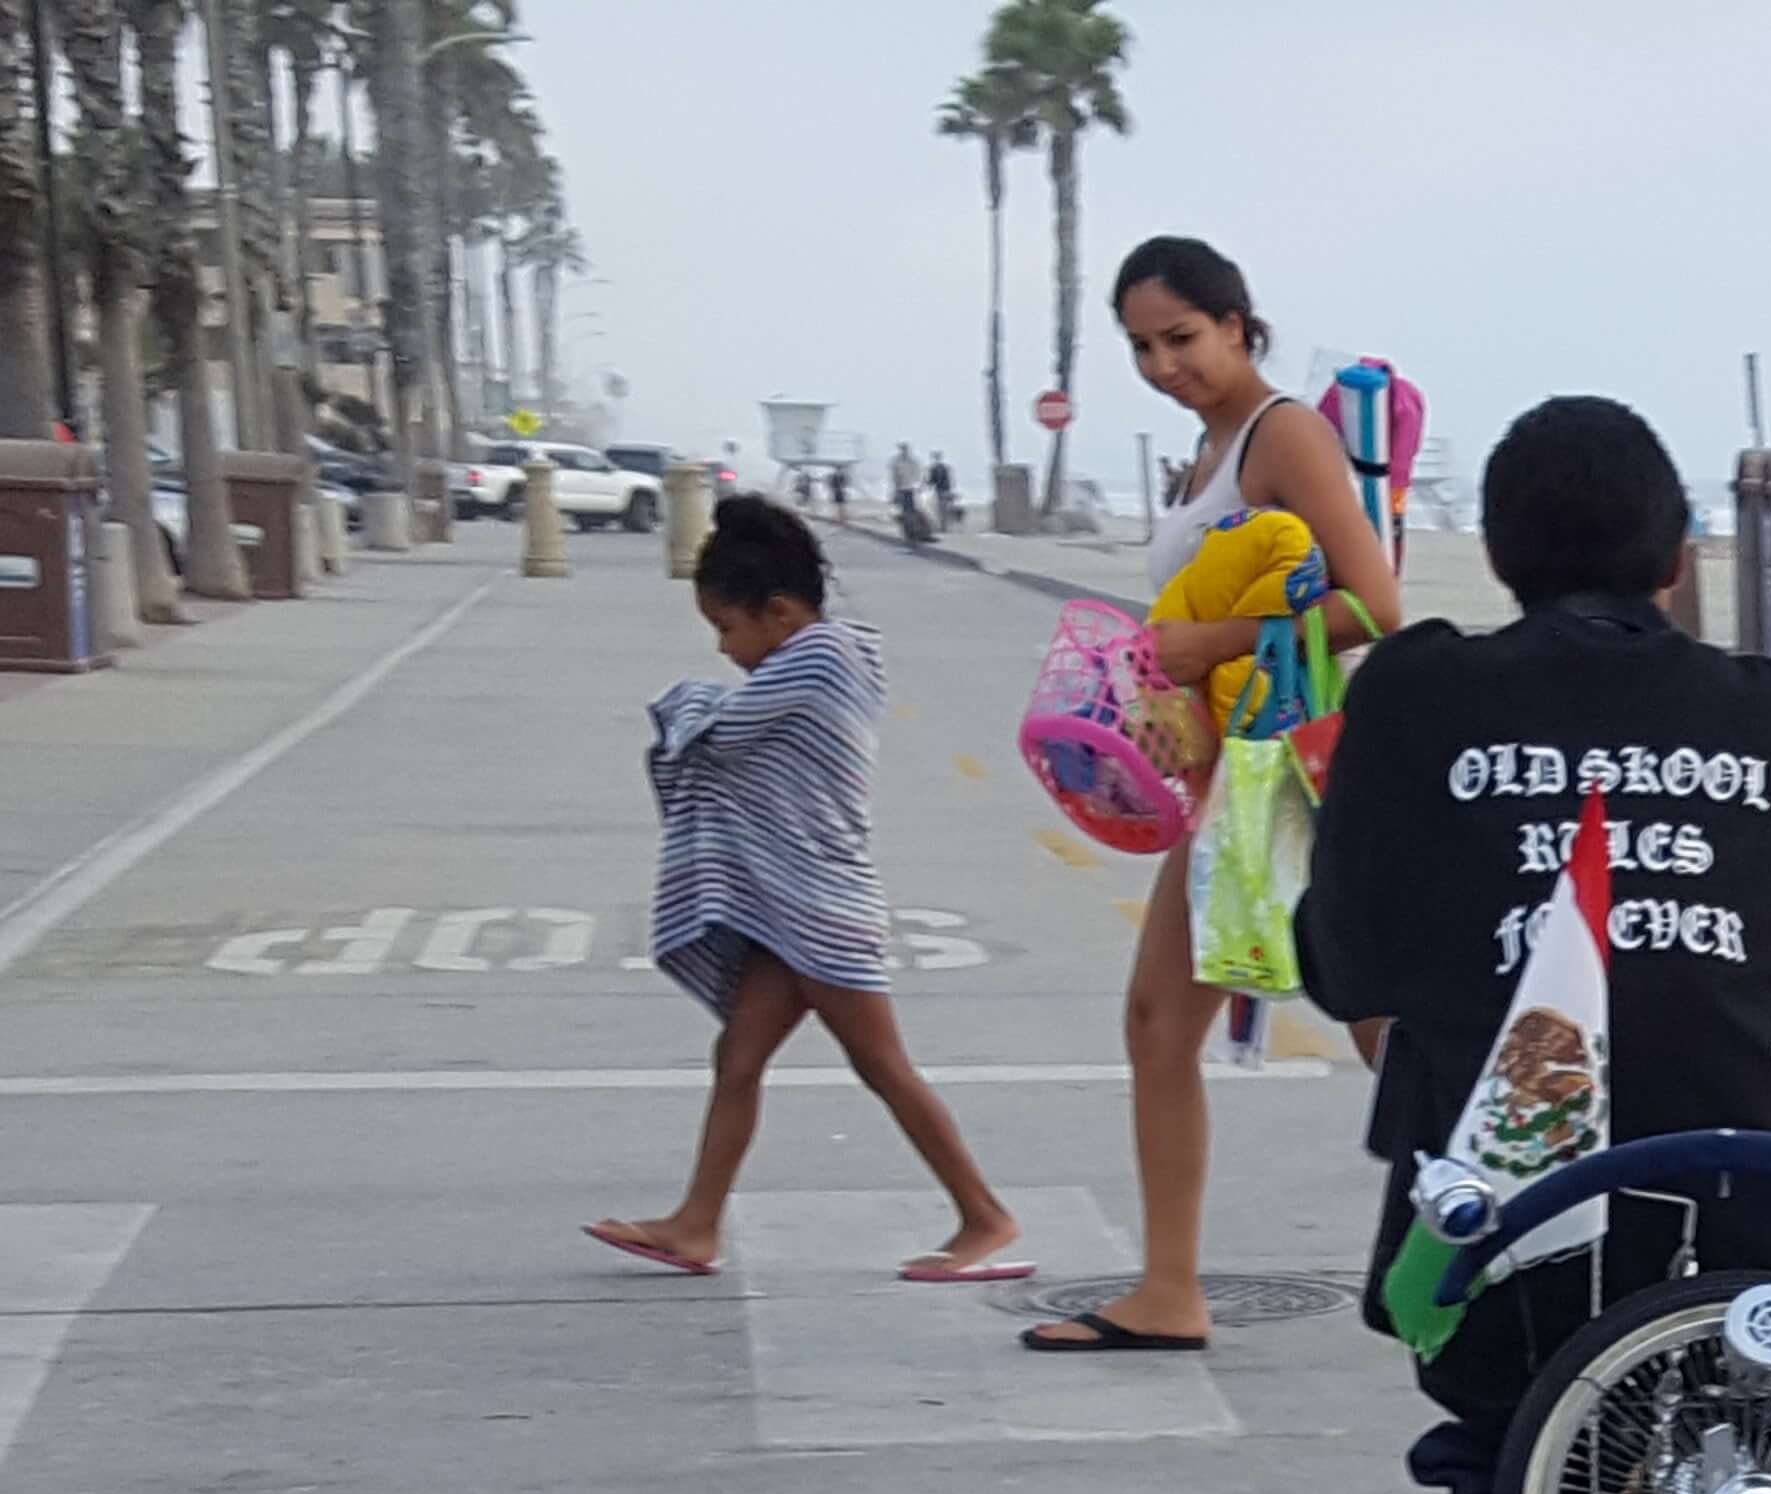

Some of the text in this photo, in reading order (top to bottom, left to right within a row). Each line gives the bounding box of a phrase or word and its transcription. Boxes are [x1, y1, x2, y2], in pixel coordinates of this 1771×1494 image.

[1448, 743, 1771, 811] OLD SKOOL
[204, 905, 991, 975] SOP
[1494, 898, 1747, 974] FEVER
